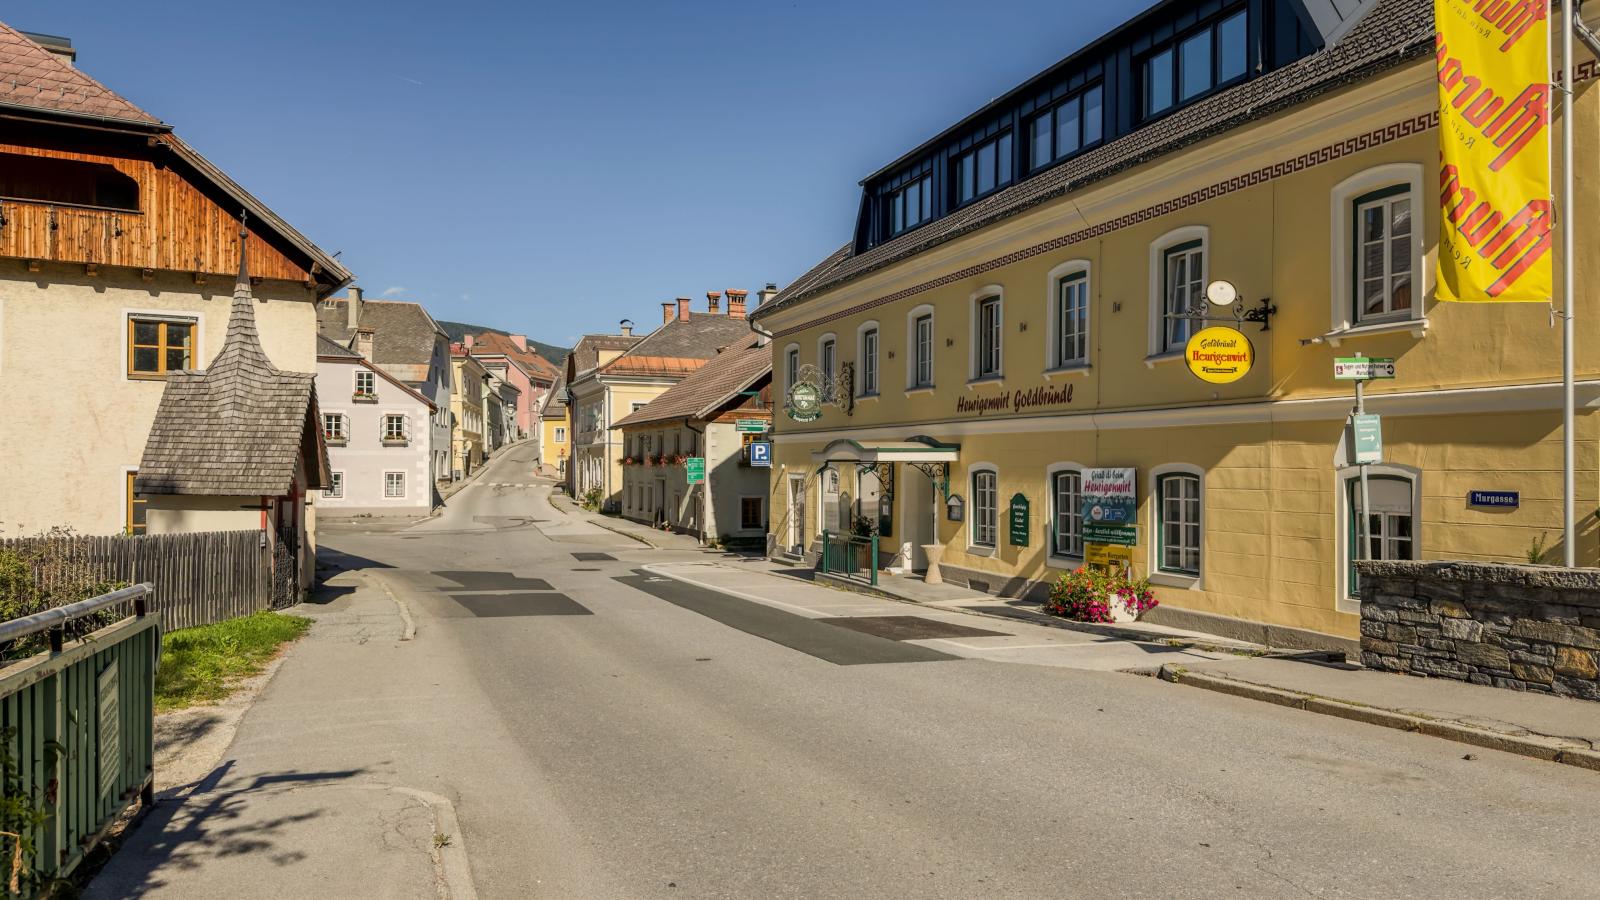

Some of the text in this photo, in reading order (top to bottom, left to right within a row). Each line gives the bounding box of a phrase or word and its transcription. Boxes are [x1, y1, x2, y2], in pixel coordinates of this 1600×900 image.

[1193, 351, 1248, 365] Heurigenwirt
[957, 384, 1073, 416] Heurigenwirt Goldbründl
[755, 445, 766, 460] P
[1084, 479, 1131, 496] Heurigenwirt
[1475, 493, 1513, 504] Murgasse
